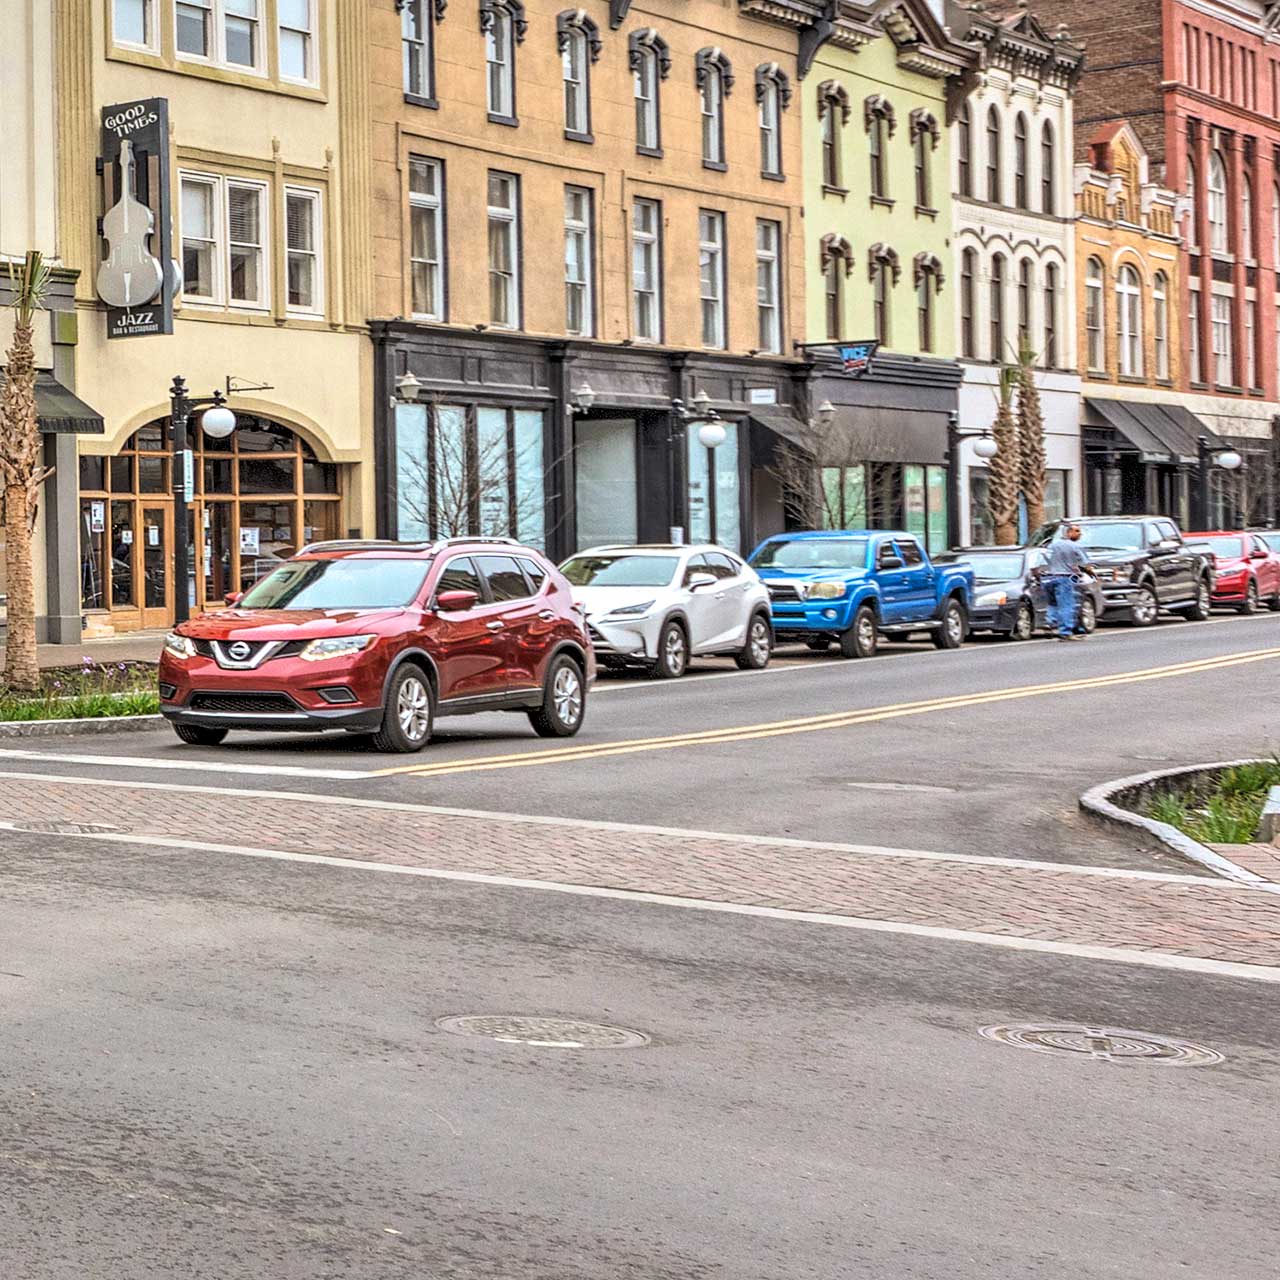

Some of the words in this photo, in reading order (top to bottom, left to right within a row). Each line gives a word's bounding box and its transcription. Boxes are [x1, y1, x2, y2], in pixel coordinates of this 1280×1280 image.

[105, 105, 145, 129] GOOD
[113, 112, 158, 137] TIMES
[117, 312, 153, 326] JAZZ
